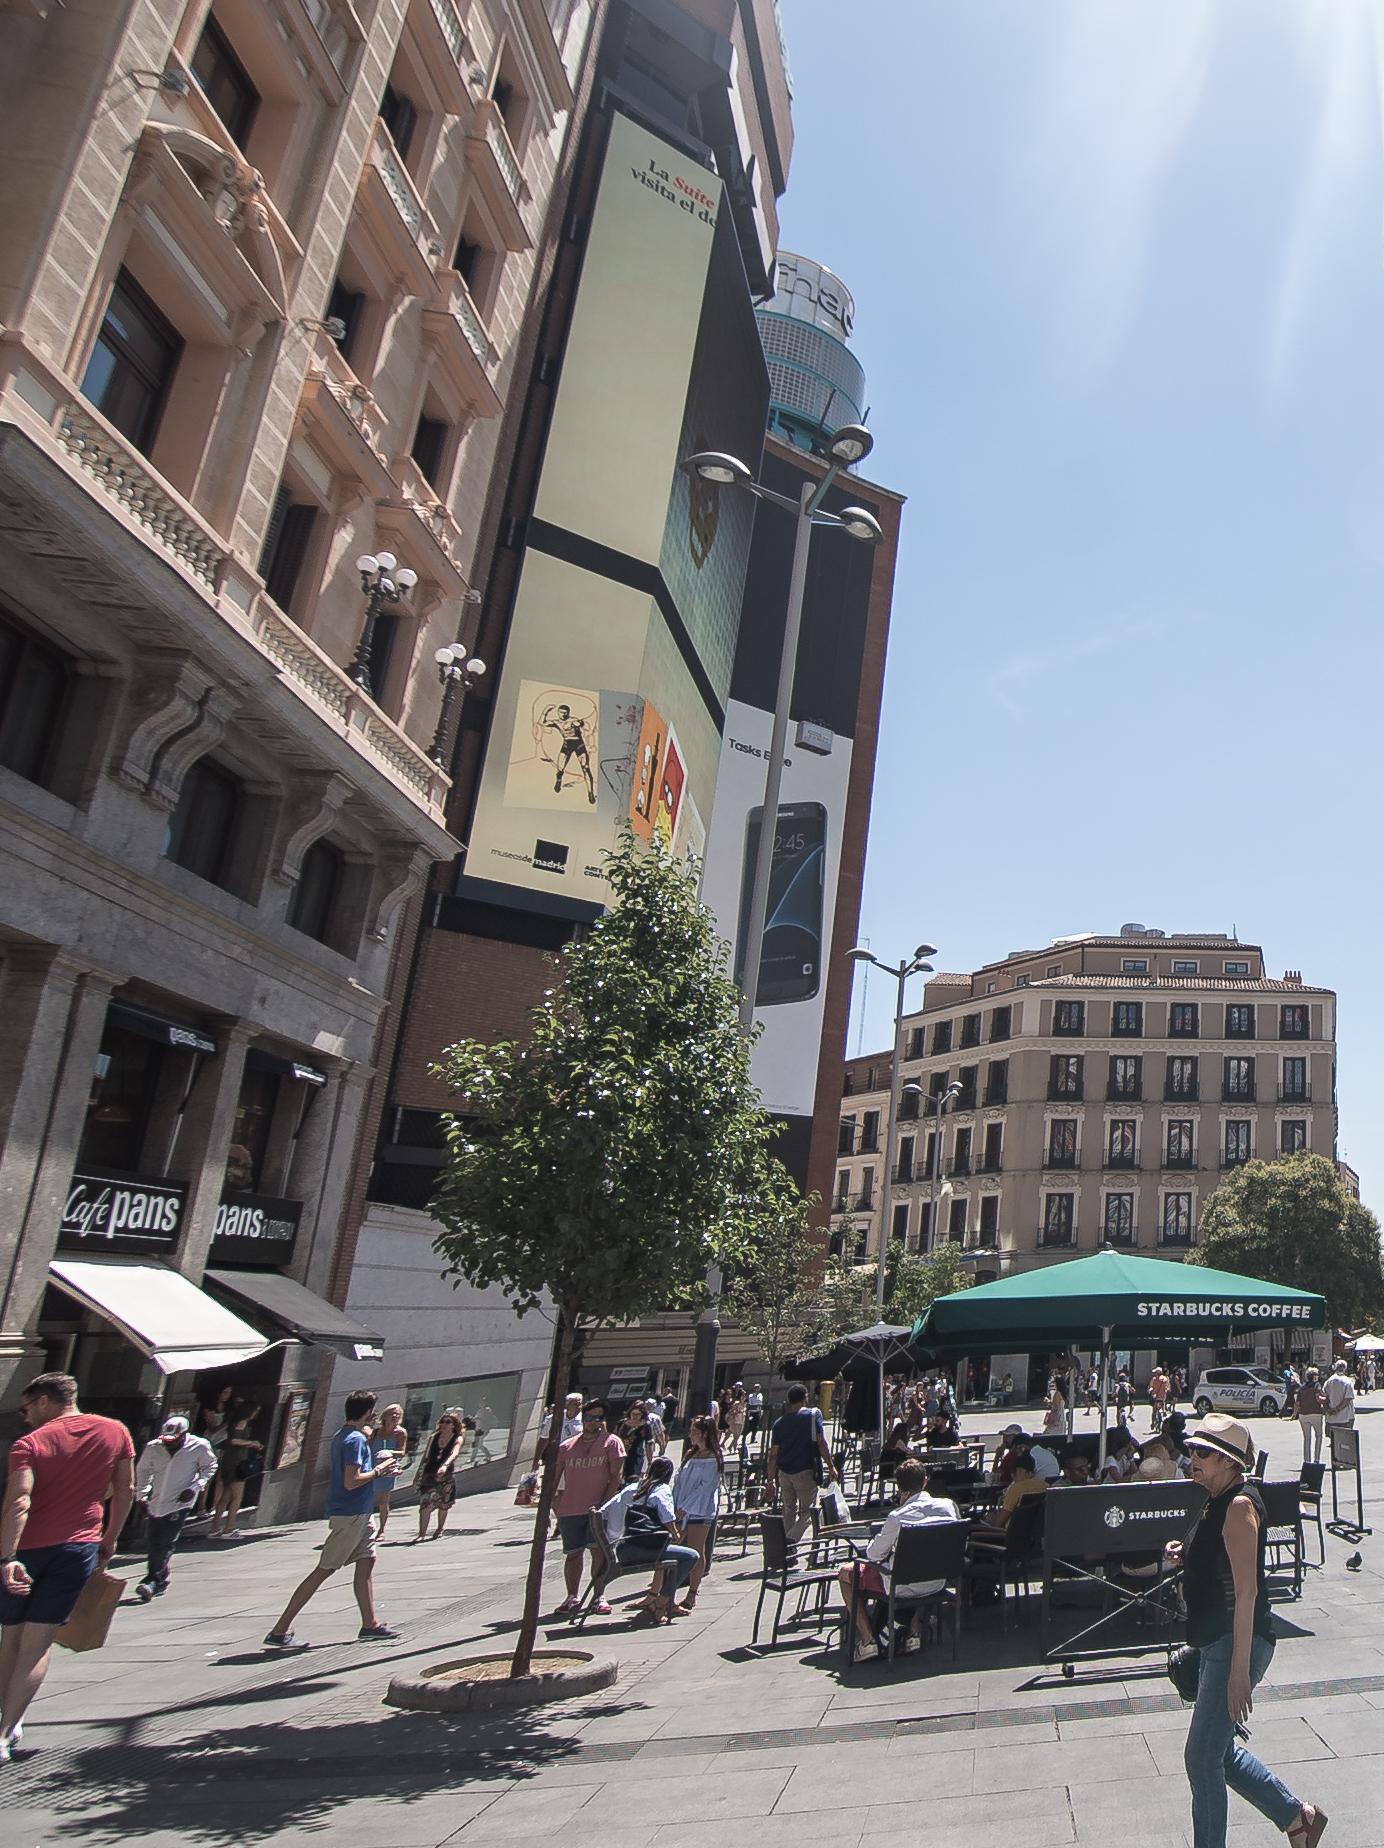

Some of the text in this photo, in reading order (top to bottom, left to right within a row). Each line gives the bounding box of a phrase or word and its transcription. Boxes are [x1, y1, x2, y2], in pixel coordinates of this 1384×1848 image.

[631, 167, 676, 204] visita
[680, 199, 695, 214] el
[649, 159, 715, 210] La Suite
[728, 737, 762, 759] Tasks
[106, 1190, 180, 1239] pans
[212, 1203, 263, 1244] pans
[1137, 1302, 1311, 1319] STARBUCKS COFFEE
[1128, 1508, 1187, 1520] STARBUCKS
